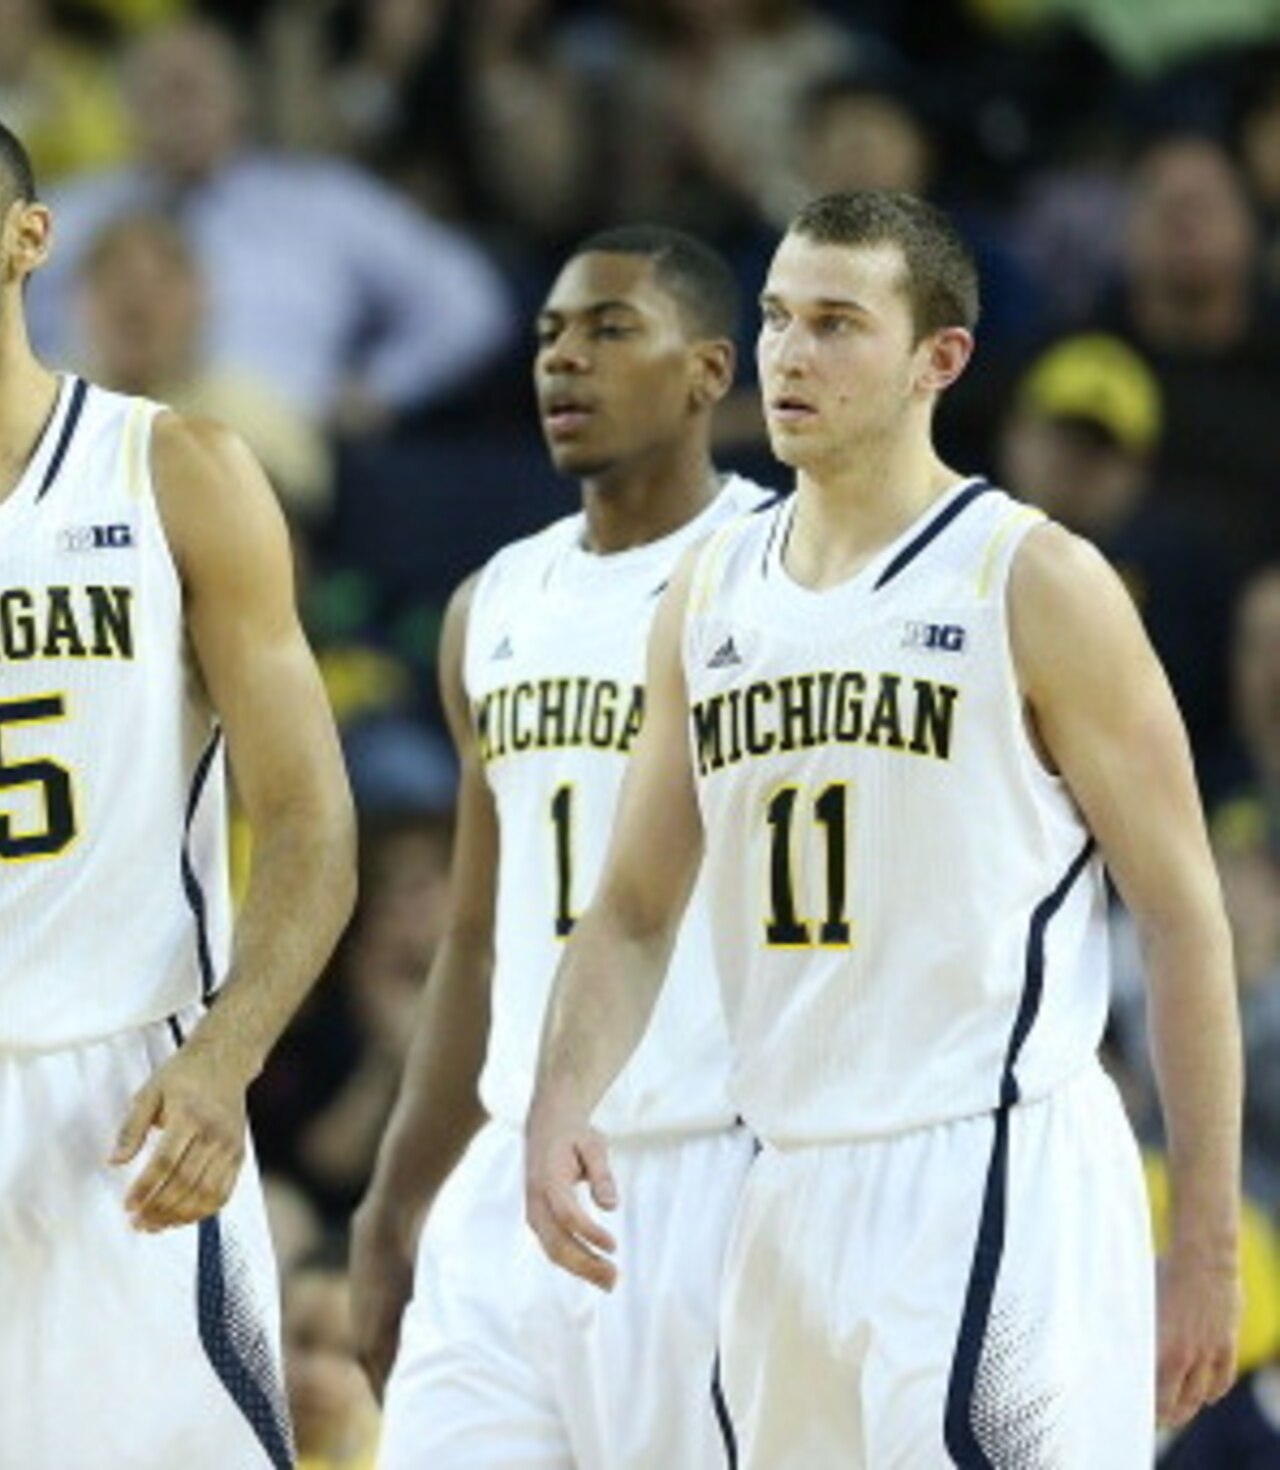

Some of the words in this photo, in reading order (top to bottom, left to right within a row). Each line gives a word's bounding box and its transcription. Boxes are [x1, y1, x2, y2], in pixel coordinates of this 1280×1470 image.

[477, 676, 647, 762] ICHIGA
[692, 671, 961, 778] MICHIGAN
[550, 782, 580, 941] 1
[761, 781, 854, 950] 11
